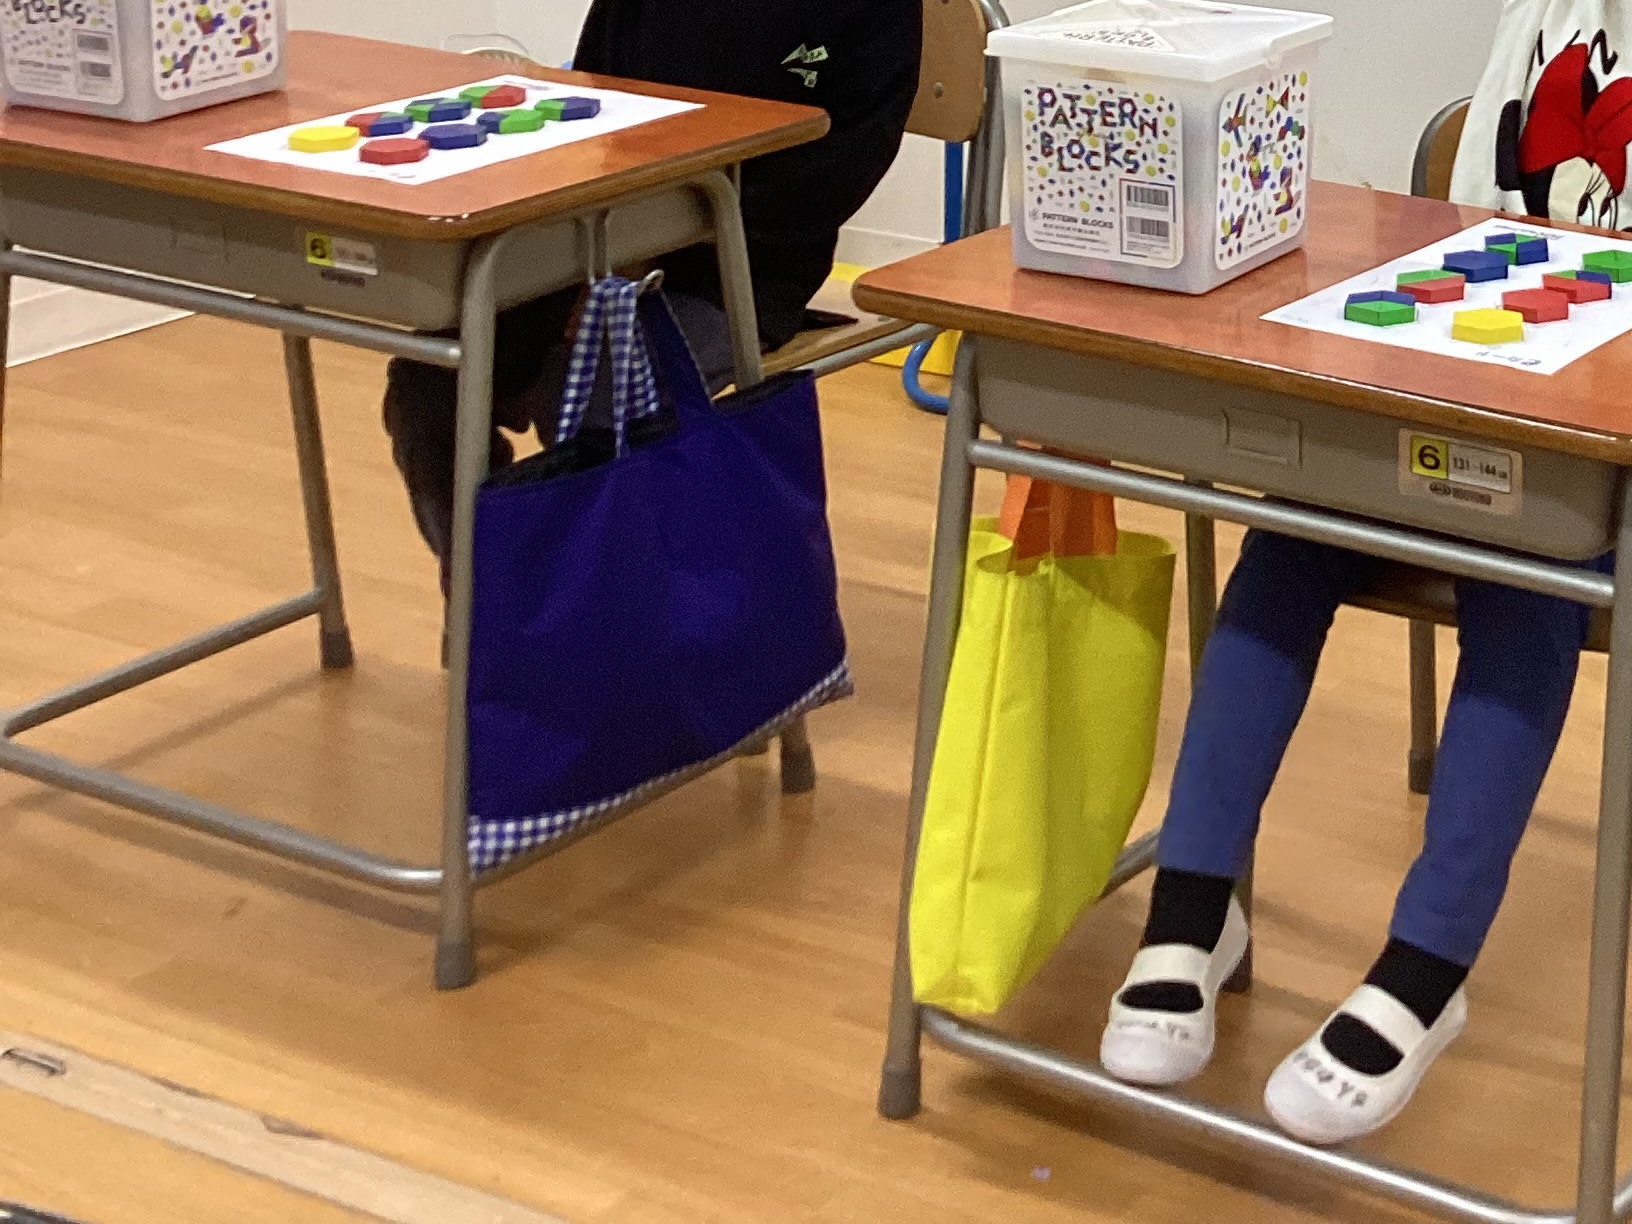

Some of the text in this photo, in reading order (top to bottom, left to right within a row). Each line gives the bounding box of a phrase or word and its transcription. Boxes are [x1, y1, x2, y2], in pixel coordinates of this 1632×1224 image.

[1037, 87, 1158, 138] PATTERN
[1040, 132, 1140, 174] BLOCKS
[1418, 445, 1440, 470] 6
